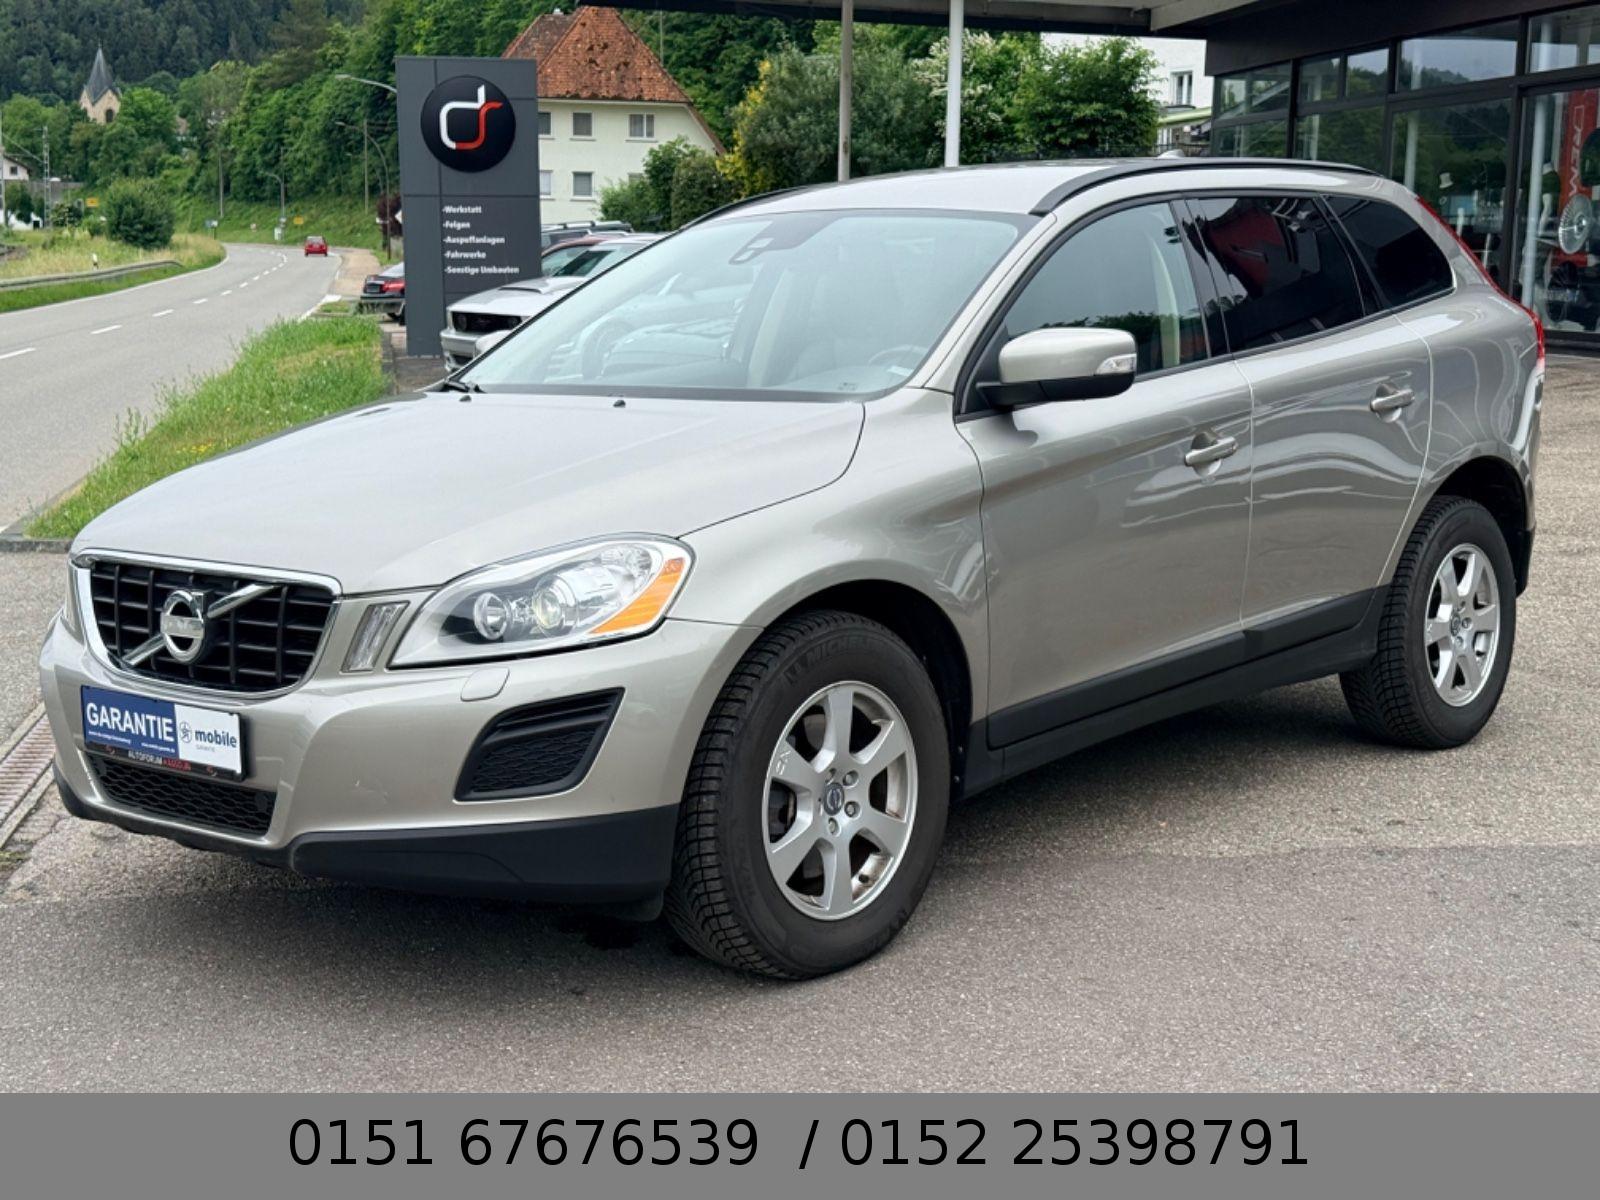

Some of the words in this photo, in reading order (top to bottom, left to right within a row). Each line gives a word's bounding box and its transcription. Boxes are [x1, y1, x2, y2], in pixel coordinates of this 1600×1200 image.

[480, 266, 519, 274] Umbauten
[86, 702, 175, 742] GARANTIE
[194, 729, 237, 748] mobile
